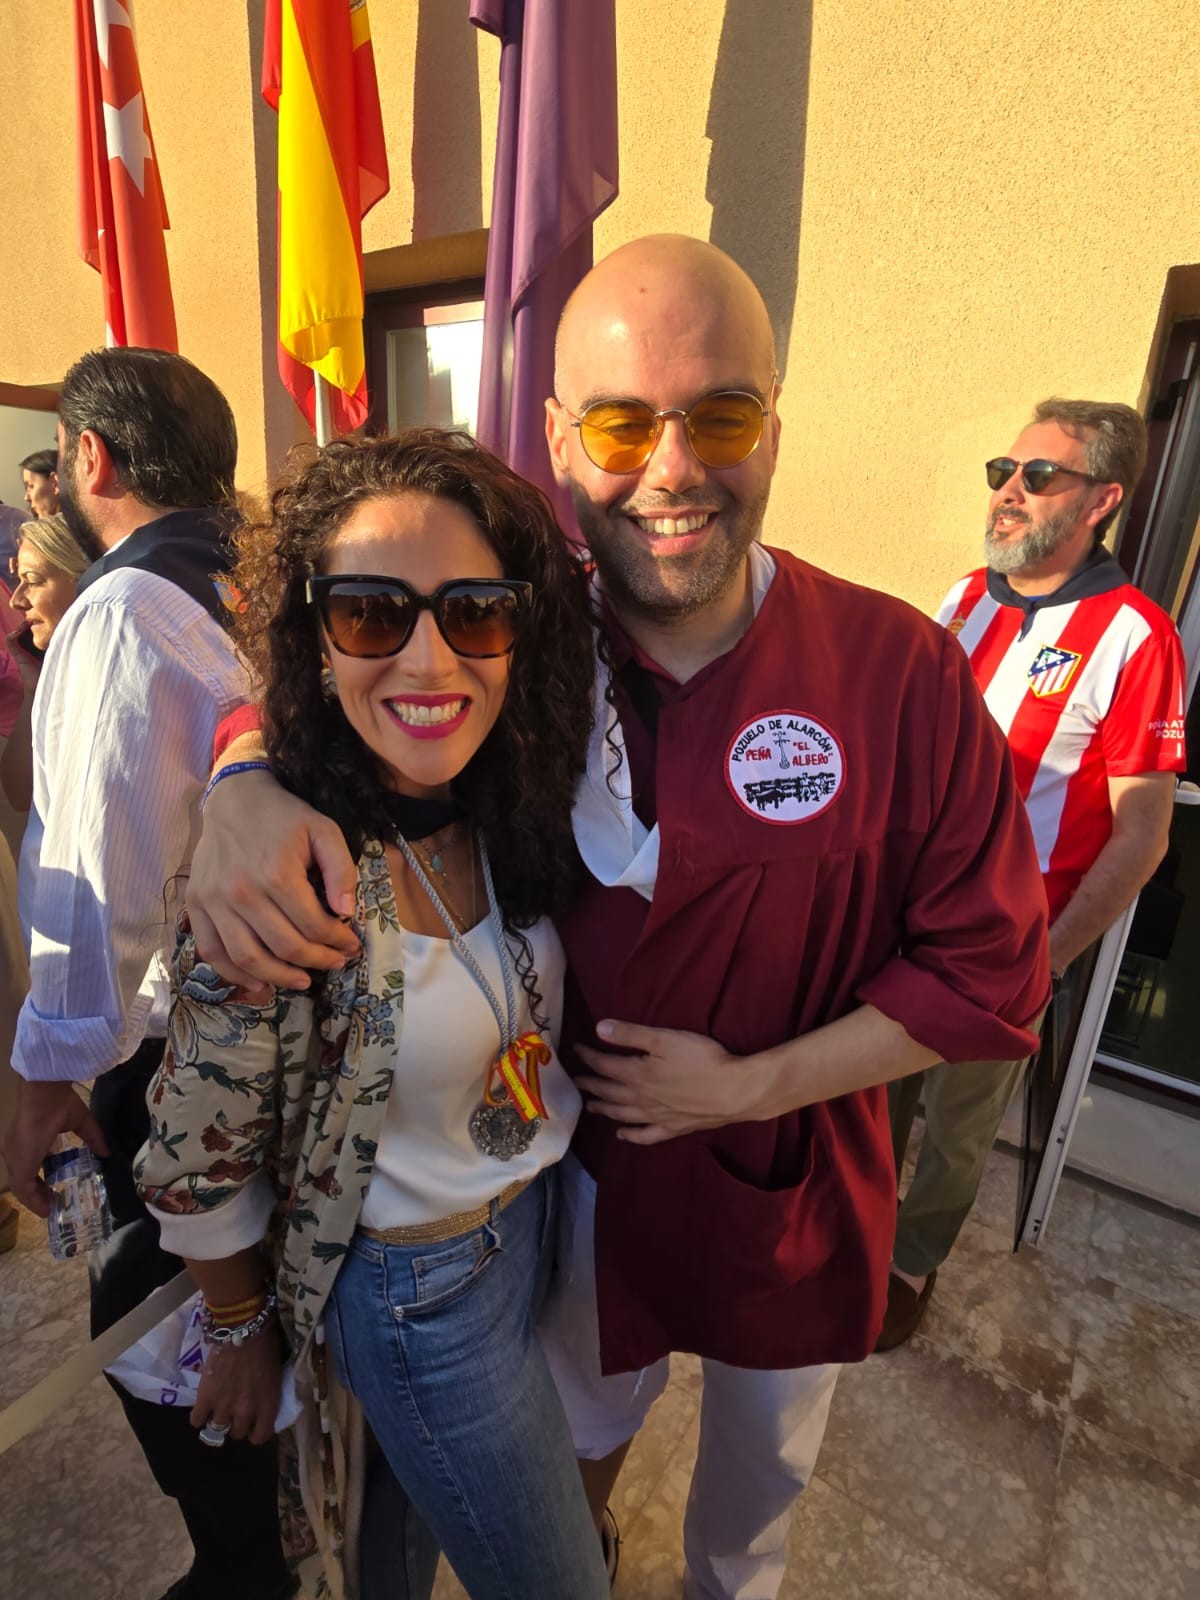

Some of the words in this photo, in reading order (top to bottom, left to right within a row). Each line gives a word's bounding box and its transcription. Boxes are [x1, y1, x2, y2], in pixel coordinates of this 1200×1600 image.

[732, 724, 765, 762] POZUELO
[768, 720, 782, 730] DE
[787, 720, 833, 752] ALARCÓN
[745, 746, 772, 761] PEÑA
